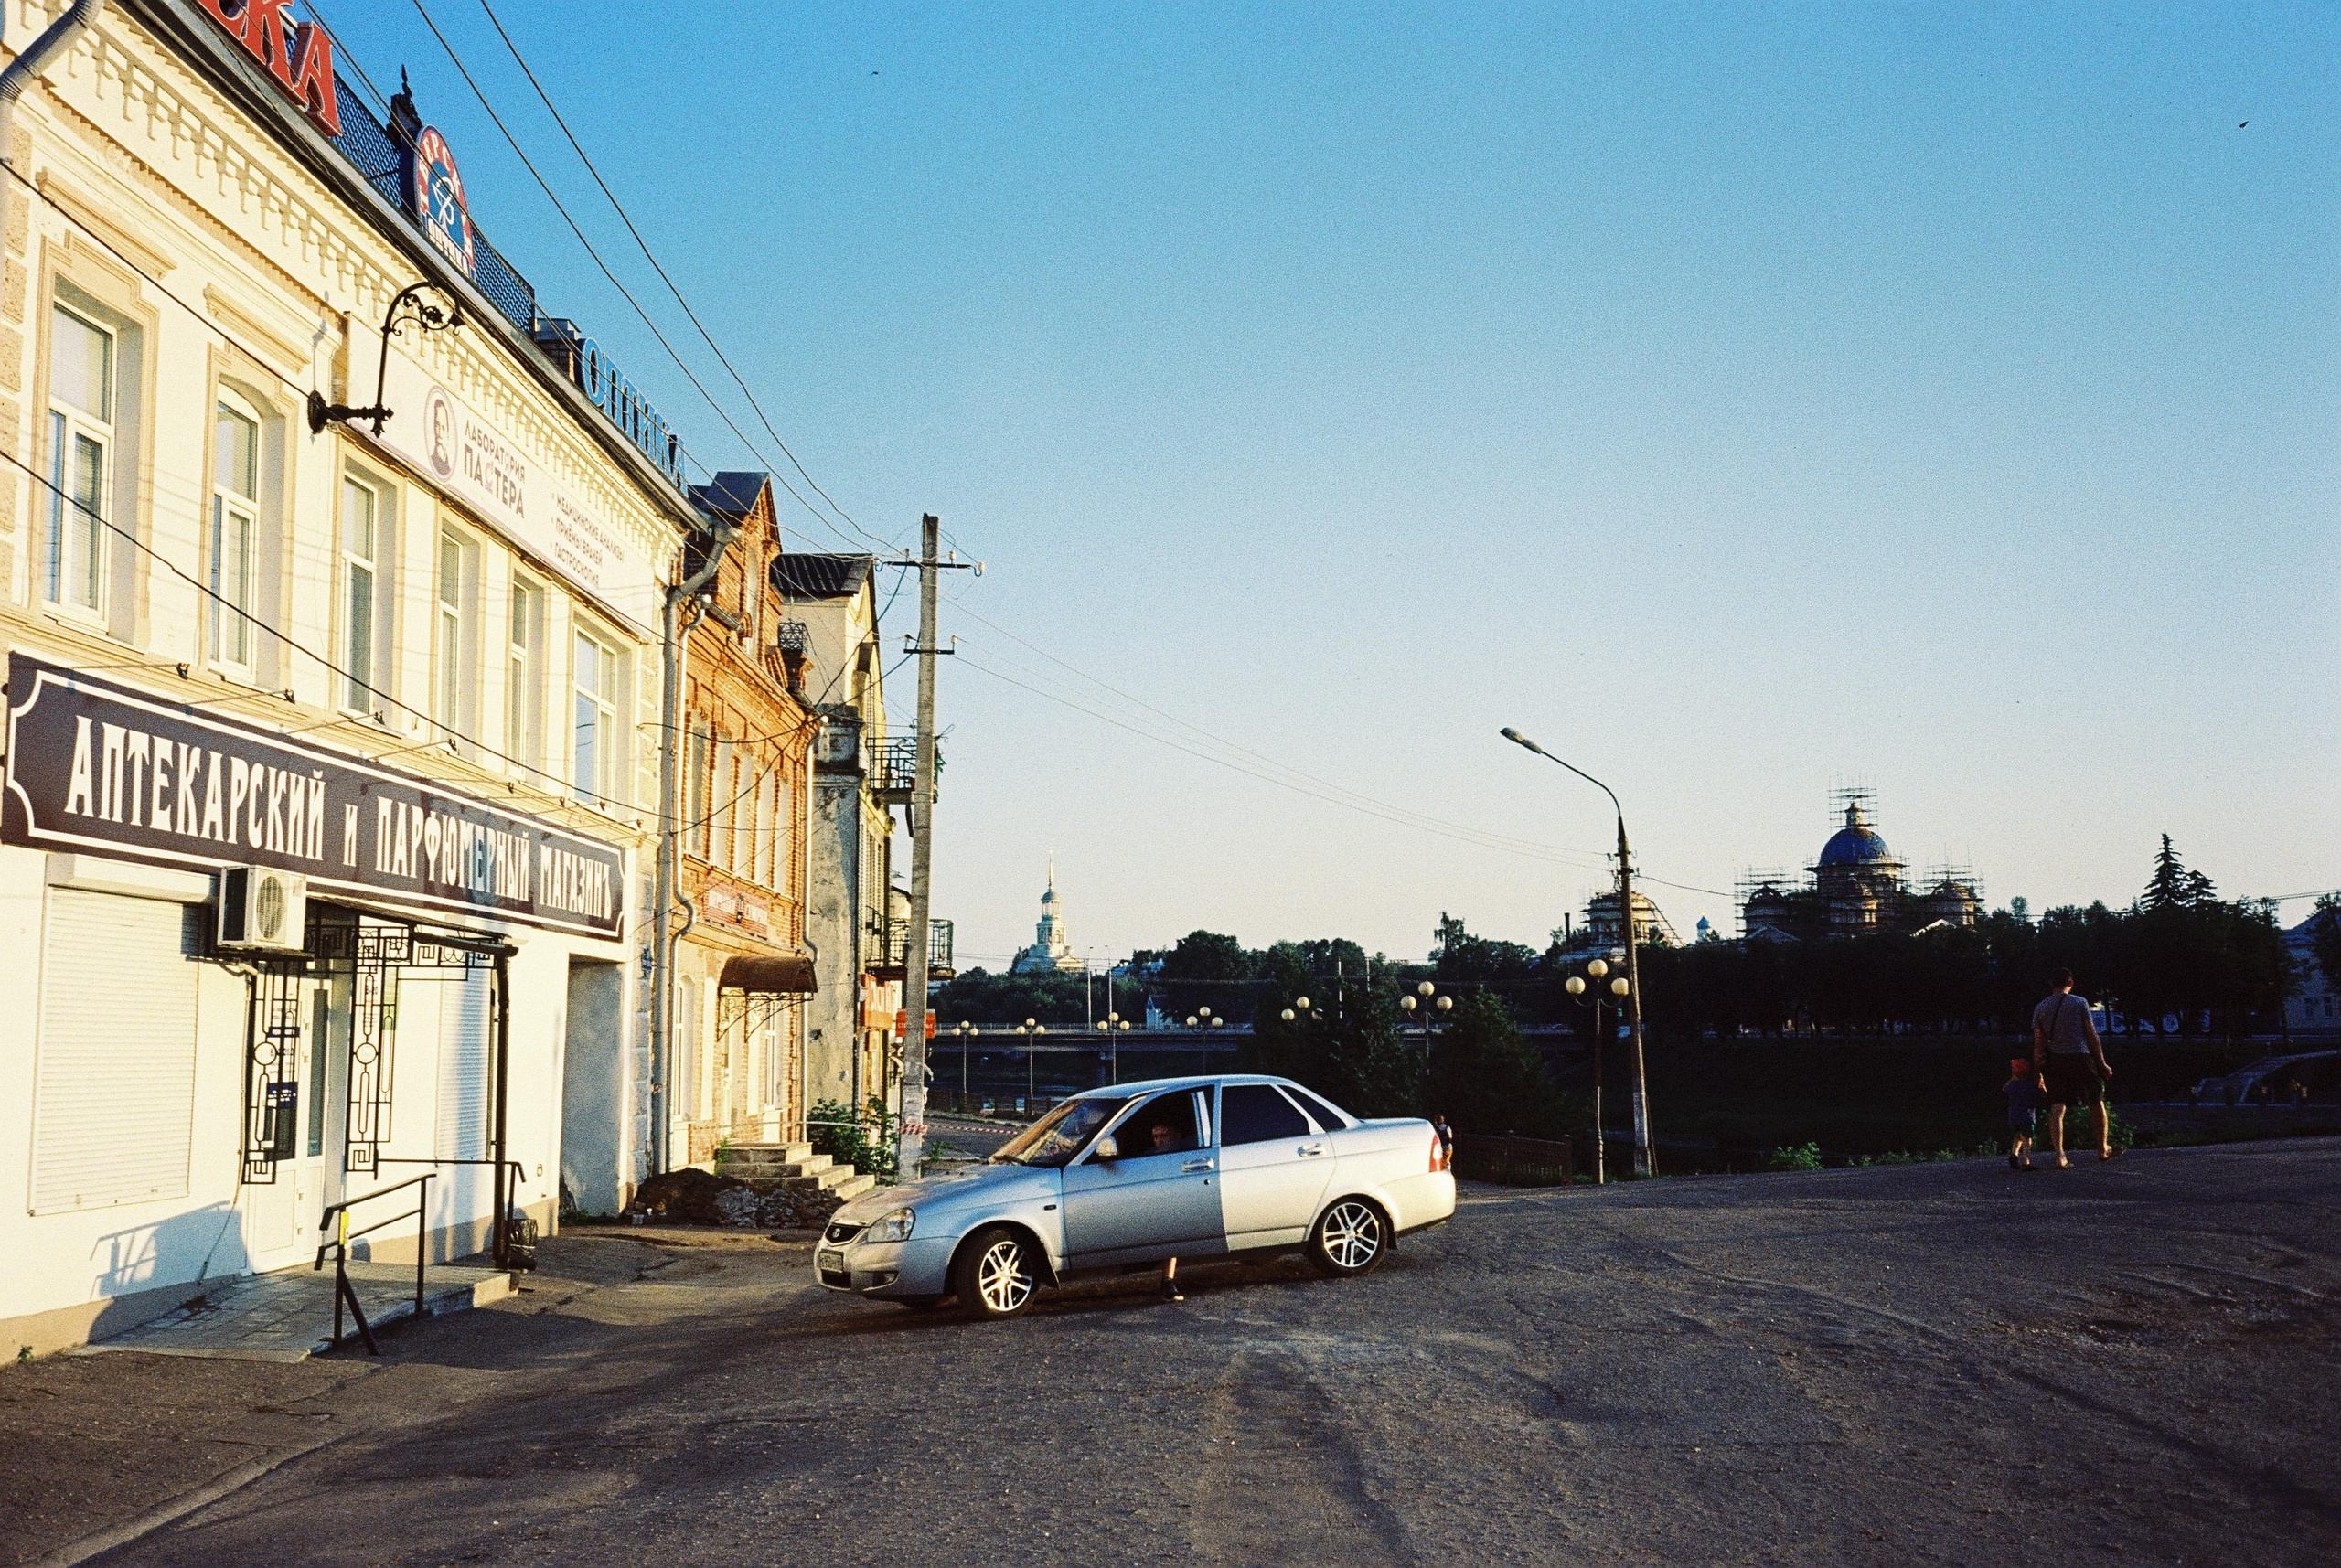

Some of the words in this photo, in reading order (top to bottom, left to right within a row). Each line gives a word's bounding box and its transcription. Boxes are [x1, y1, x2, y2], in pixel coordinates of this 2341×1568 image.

[465, 419, 525, 484] ЛАБОРАТОРИЯ
[583, 337, 689, 499] ОПТИКА
[464, 443, 525, 519] ПАСТЕРА
[557, 494, 599, 541] МЕДИЦИНСКИЕ
[64, 715, 326, 861] АПТЕКАРСКИЙ
[375, 795, 530, 901] ПАРФЮМЕРНЫЙ
[540, 844, 612, 920] МАГАЗИНЪ
